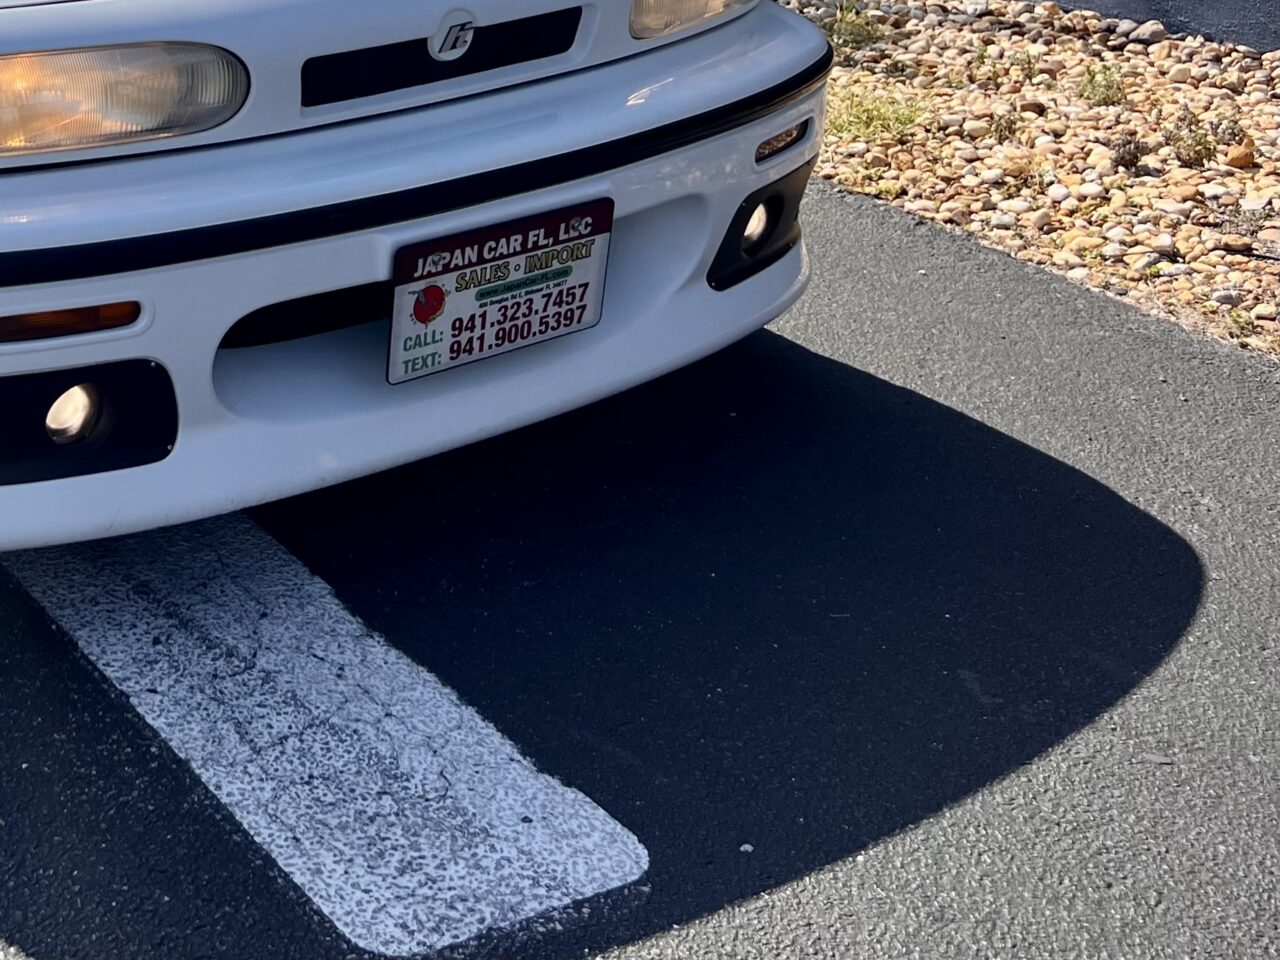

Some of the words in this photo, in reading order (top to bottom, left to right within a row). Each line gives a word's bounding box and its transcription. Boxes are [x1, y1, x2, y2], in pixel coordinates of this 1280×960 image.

[413, 245, 478, 278] JAPAN
[483, 234, 523, 260] CAR
[527, 228, 553, 248] FL,
[455, 261, 510, 292] SALES
[524, 239, 596, 275] IMPORT
[403, 329, 444, 352] CALL:
[451, 282, 590, 339] 941.323.7457
[403, 352, 442, 375] TEXT:
[449, 304, 588, 361] 941.900.5397
